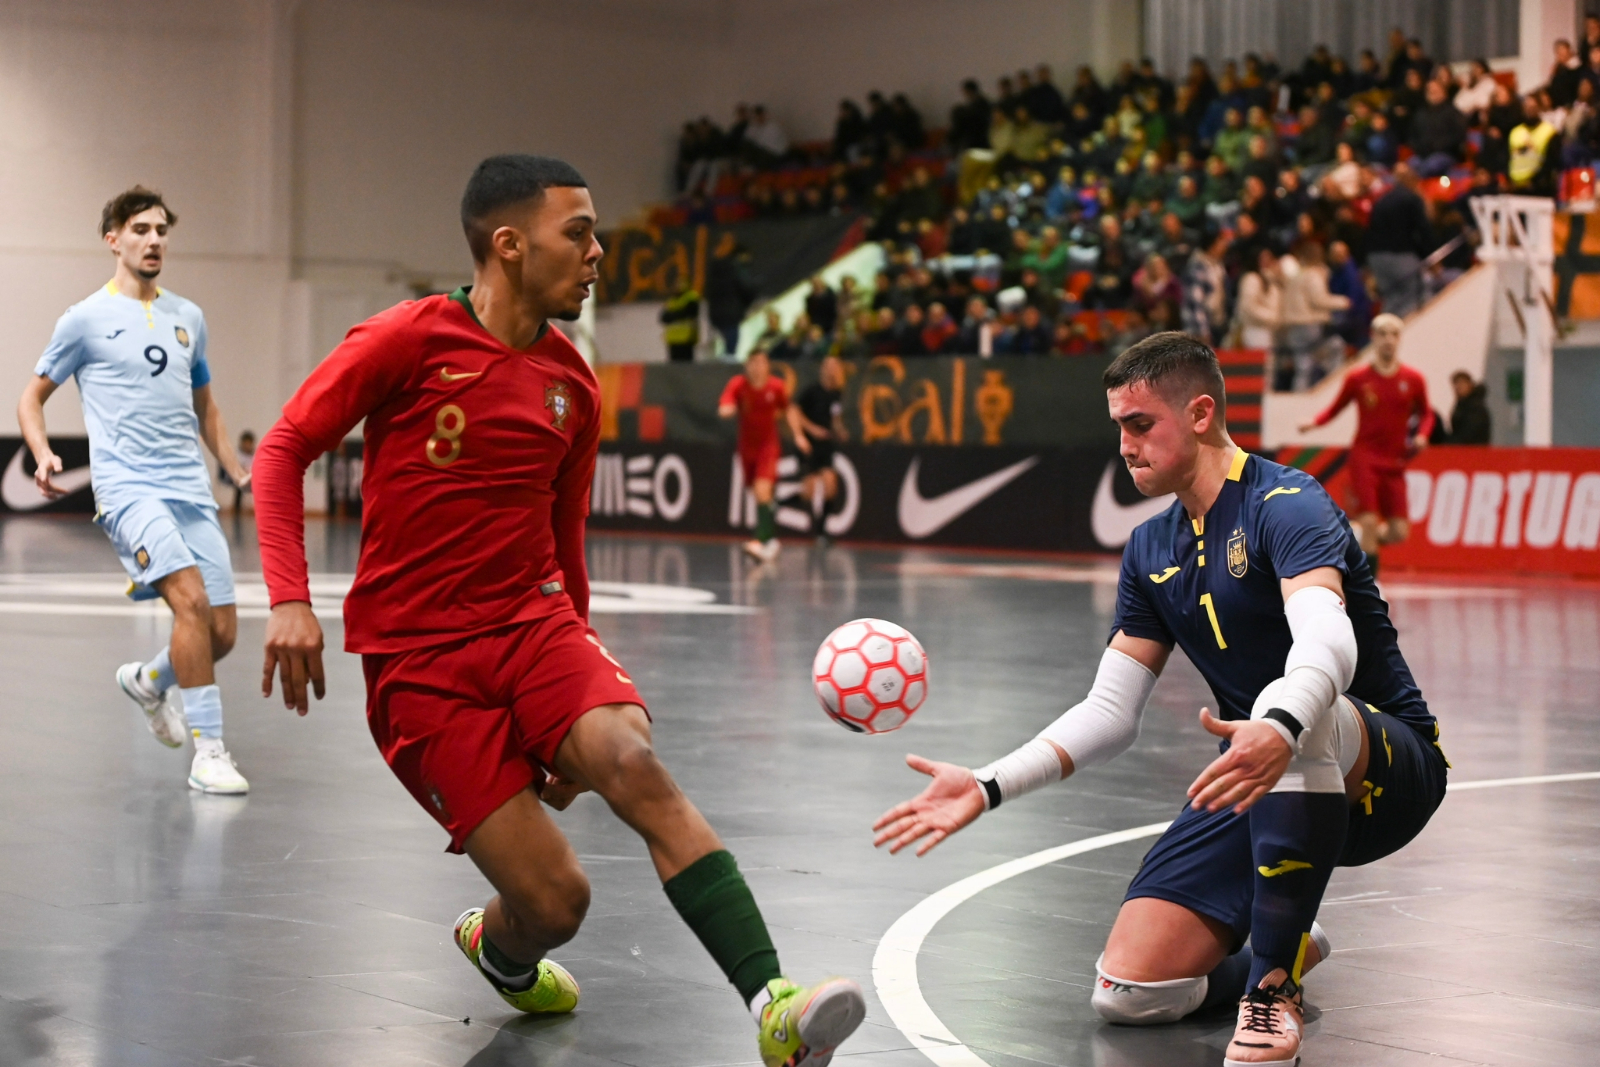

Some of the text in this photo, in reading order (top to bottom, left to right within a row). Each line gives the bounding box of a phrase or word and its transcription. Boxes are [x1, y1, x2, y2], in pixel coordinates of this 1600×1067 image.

[144, 344, 168, 377] 9
[425, 404, 465, 466] 8
[591, 453, 692, 521] MEO
[1199, 592, 1228, 650] 1
